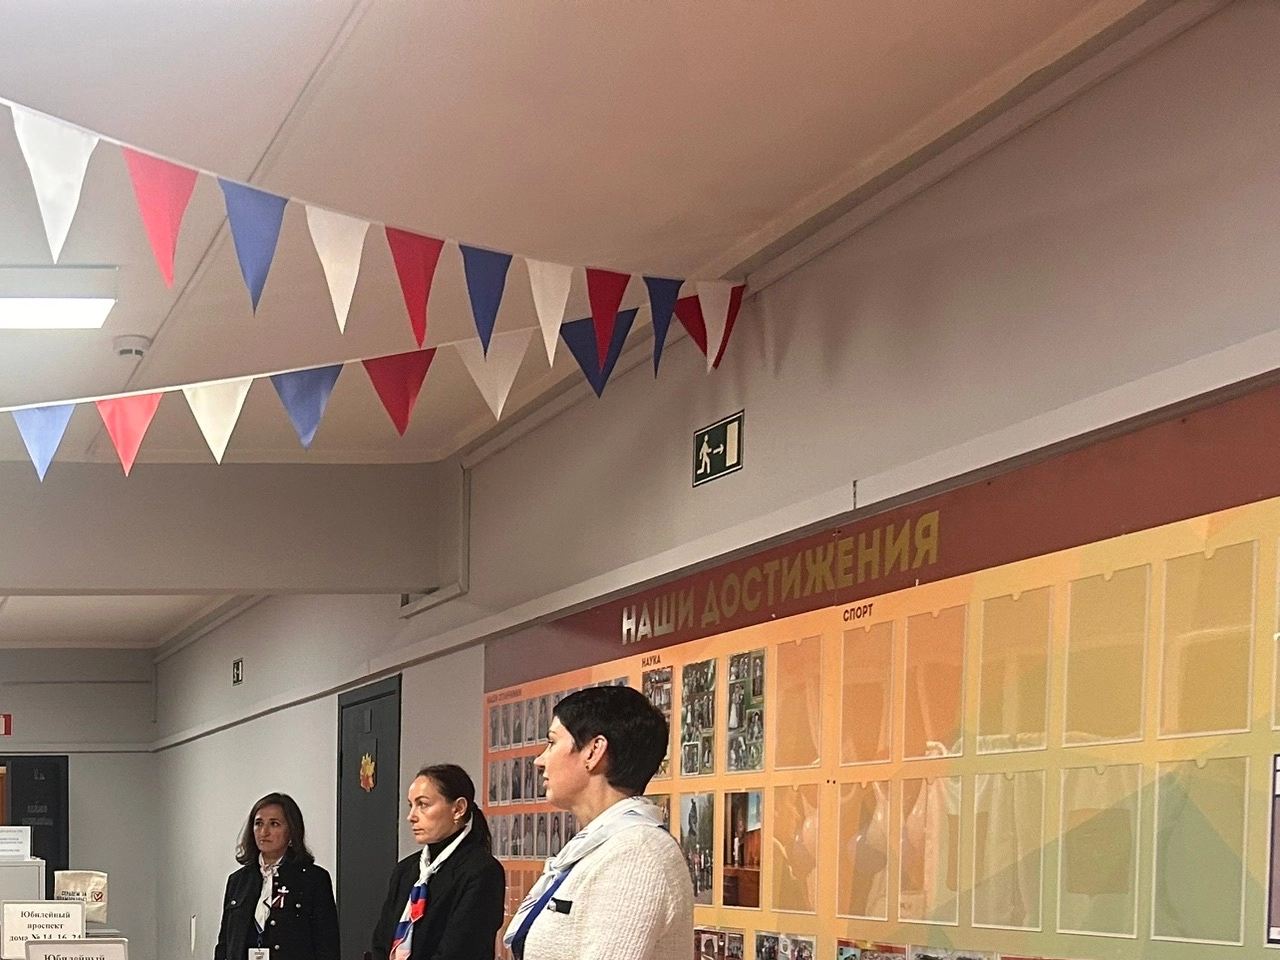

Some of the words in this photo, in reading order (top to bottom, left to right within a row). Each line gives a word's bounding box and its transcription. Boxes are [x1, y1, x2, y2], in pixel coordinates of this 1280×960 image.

[622, 587, 694, 646] НАШИ
[701, 510, 940, 629] ДОСТИЖЕНИЯ
[843, 603, 873, 621] СПОРТ
[641, 654, 661, 668] НАУКА
